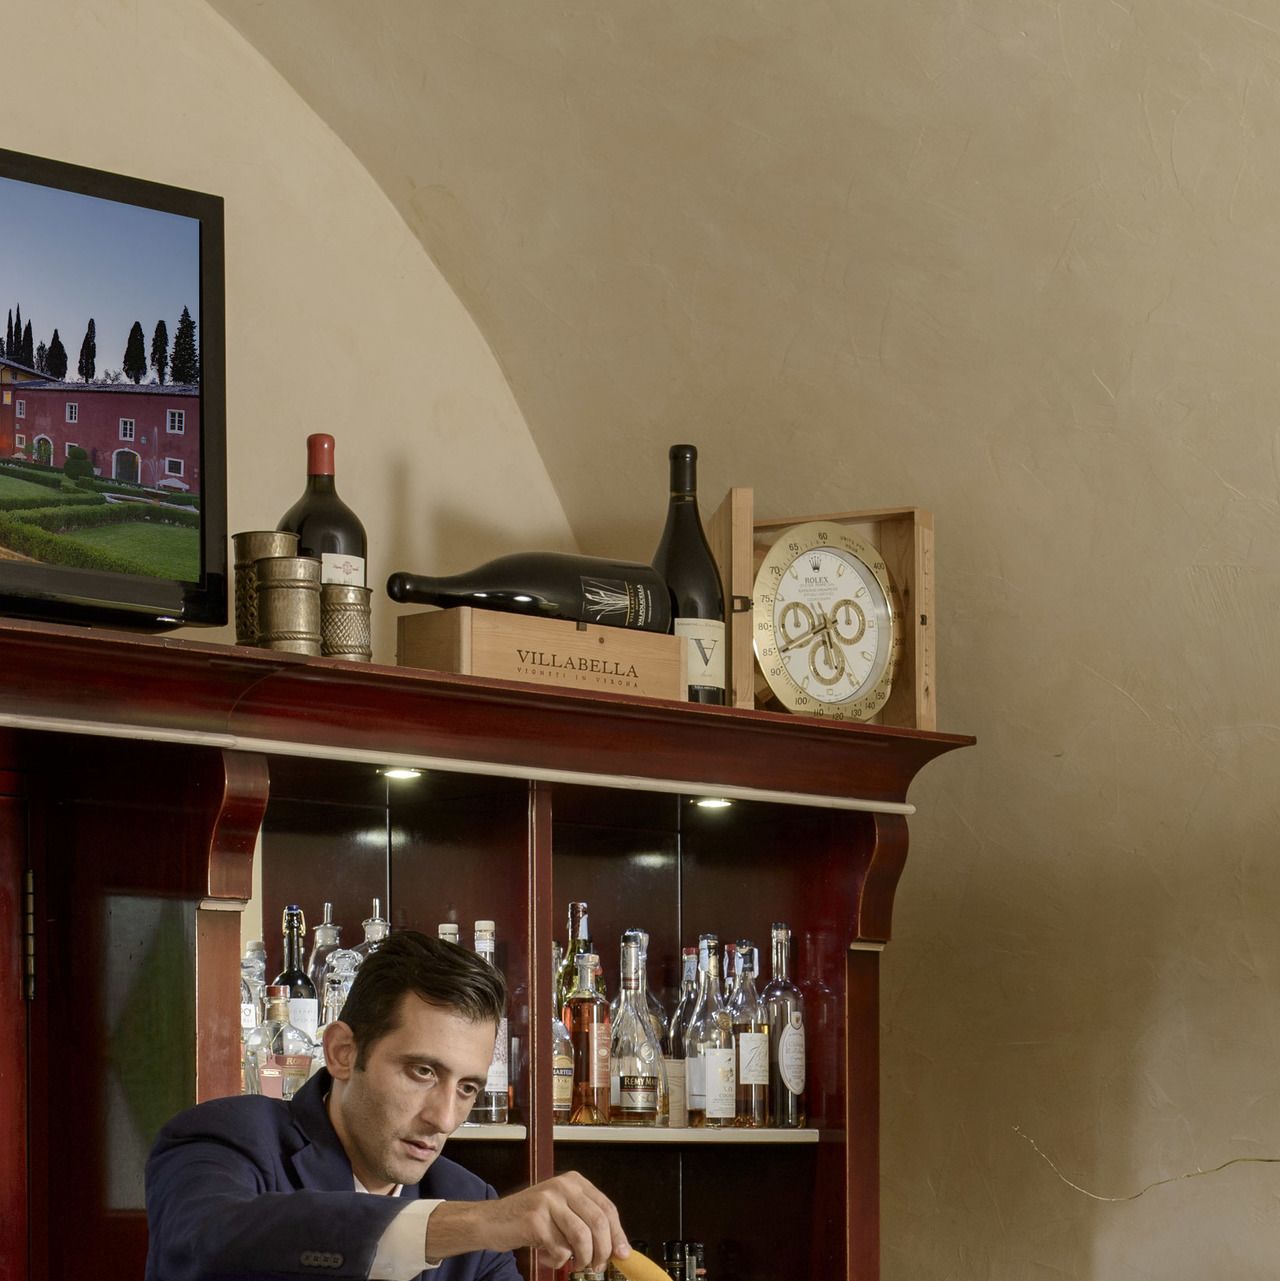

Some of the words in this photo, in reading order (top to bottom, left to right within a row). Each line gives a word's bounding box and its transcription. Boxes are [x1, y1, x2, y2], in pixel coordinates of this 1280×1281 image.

[818, 532, 827, 541] 60
[788, 543, 799, 551] 65
[769, 566, 780, 574] 70
[873, 562, 885, 571] 400
[804, 576, 829, 584] ROLEX
[760, 594, 770, 602] 75
[762, 648, 773, 656] 85
[516, 649, 639, 678] VILLABELLA
[770, 668, 781, 676] 90
[794, 696, 807, 705] 100
[813, 708, 824, 717] 110
[851, 708, 862, 717] 130
